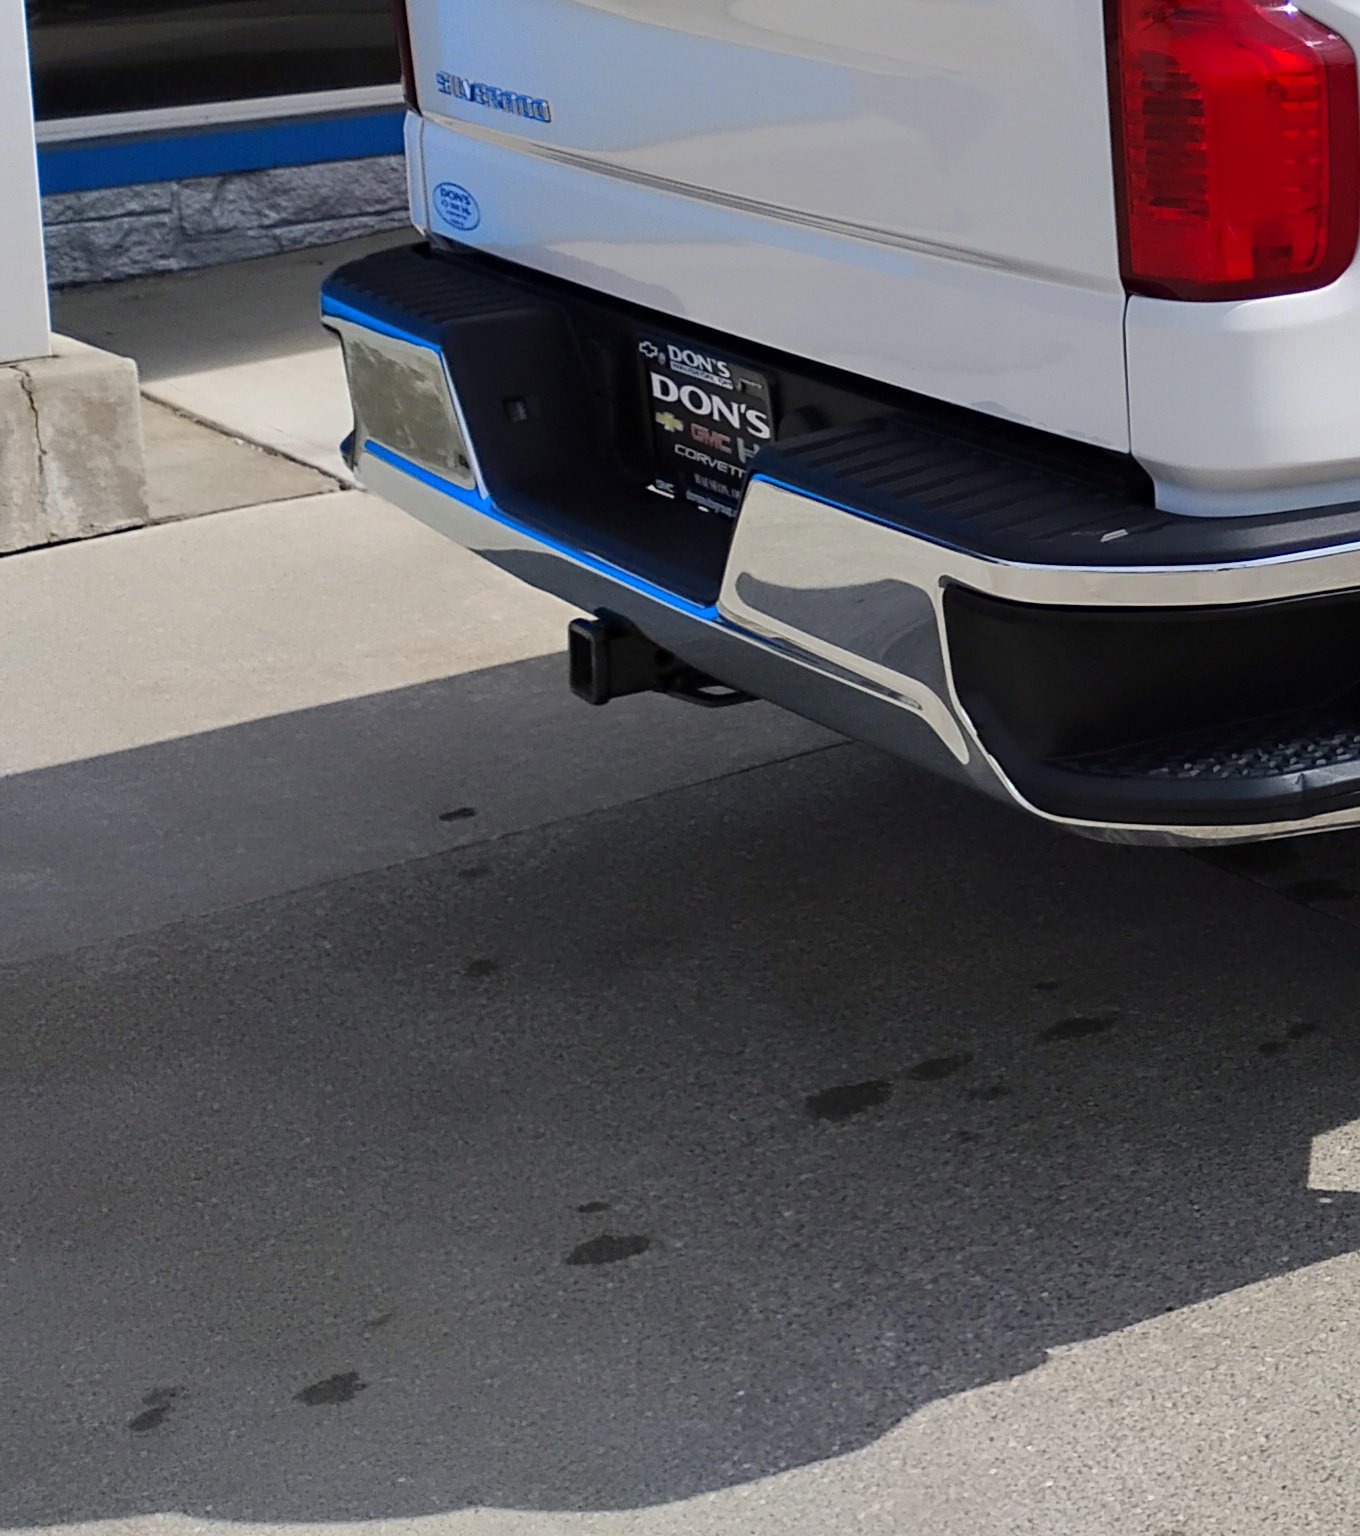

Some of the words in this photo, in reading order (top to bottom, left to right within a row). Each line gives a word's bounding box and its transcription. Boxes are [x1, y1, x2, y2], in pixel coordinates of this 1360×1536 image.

[667, 344, 731, 378] DON'S
[650, 371, 771, 439] DON'S
[691, 424, 732, 454] GMC
[674, 443, 747, 478] CORVETT
